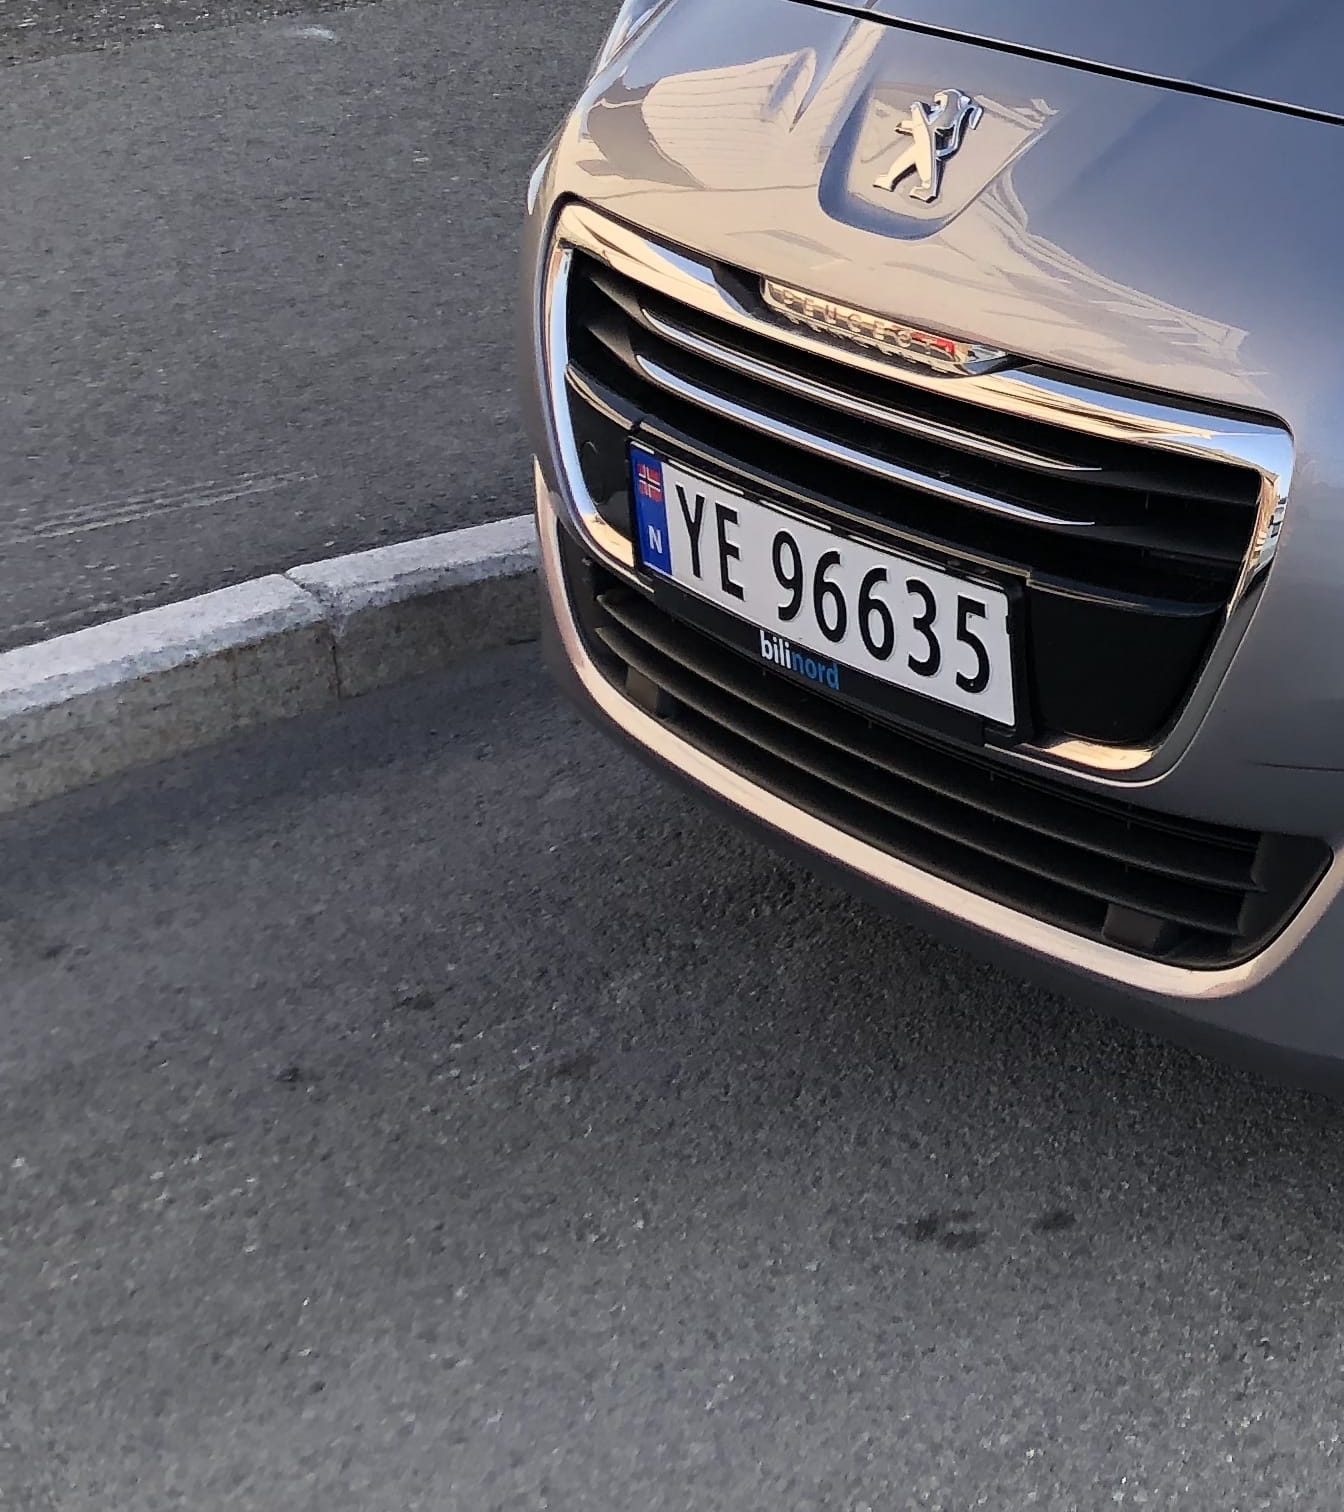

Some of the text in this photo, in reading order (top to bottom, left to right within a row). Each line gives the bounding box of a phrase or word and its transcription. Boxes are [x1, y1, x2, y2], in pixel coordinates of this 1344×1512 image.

[647, 524, 664, 555] N
[674, 482, 991, 694] YE 96635
[759, 630, 841, 691] bilinord
